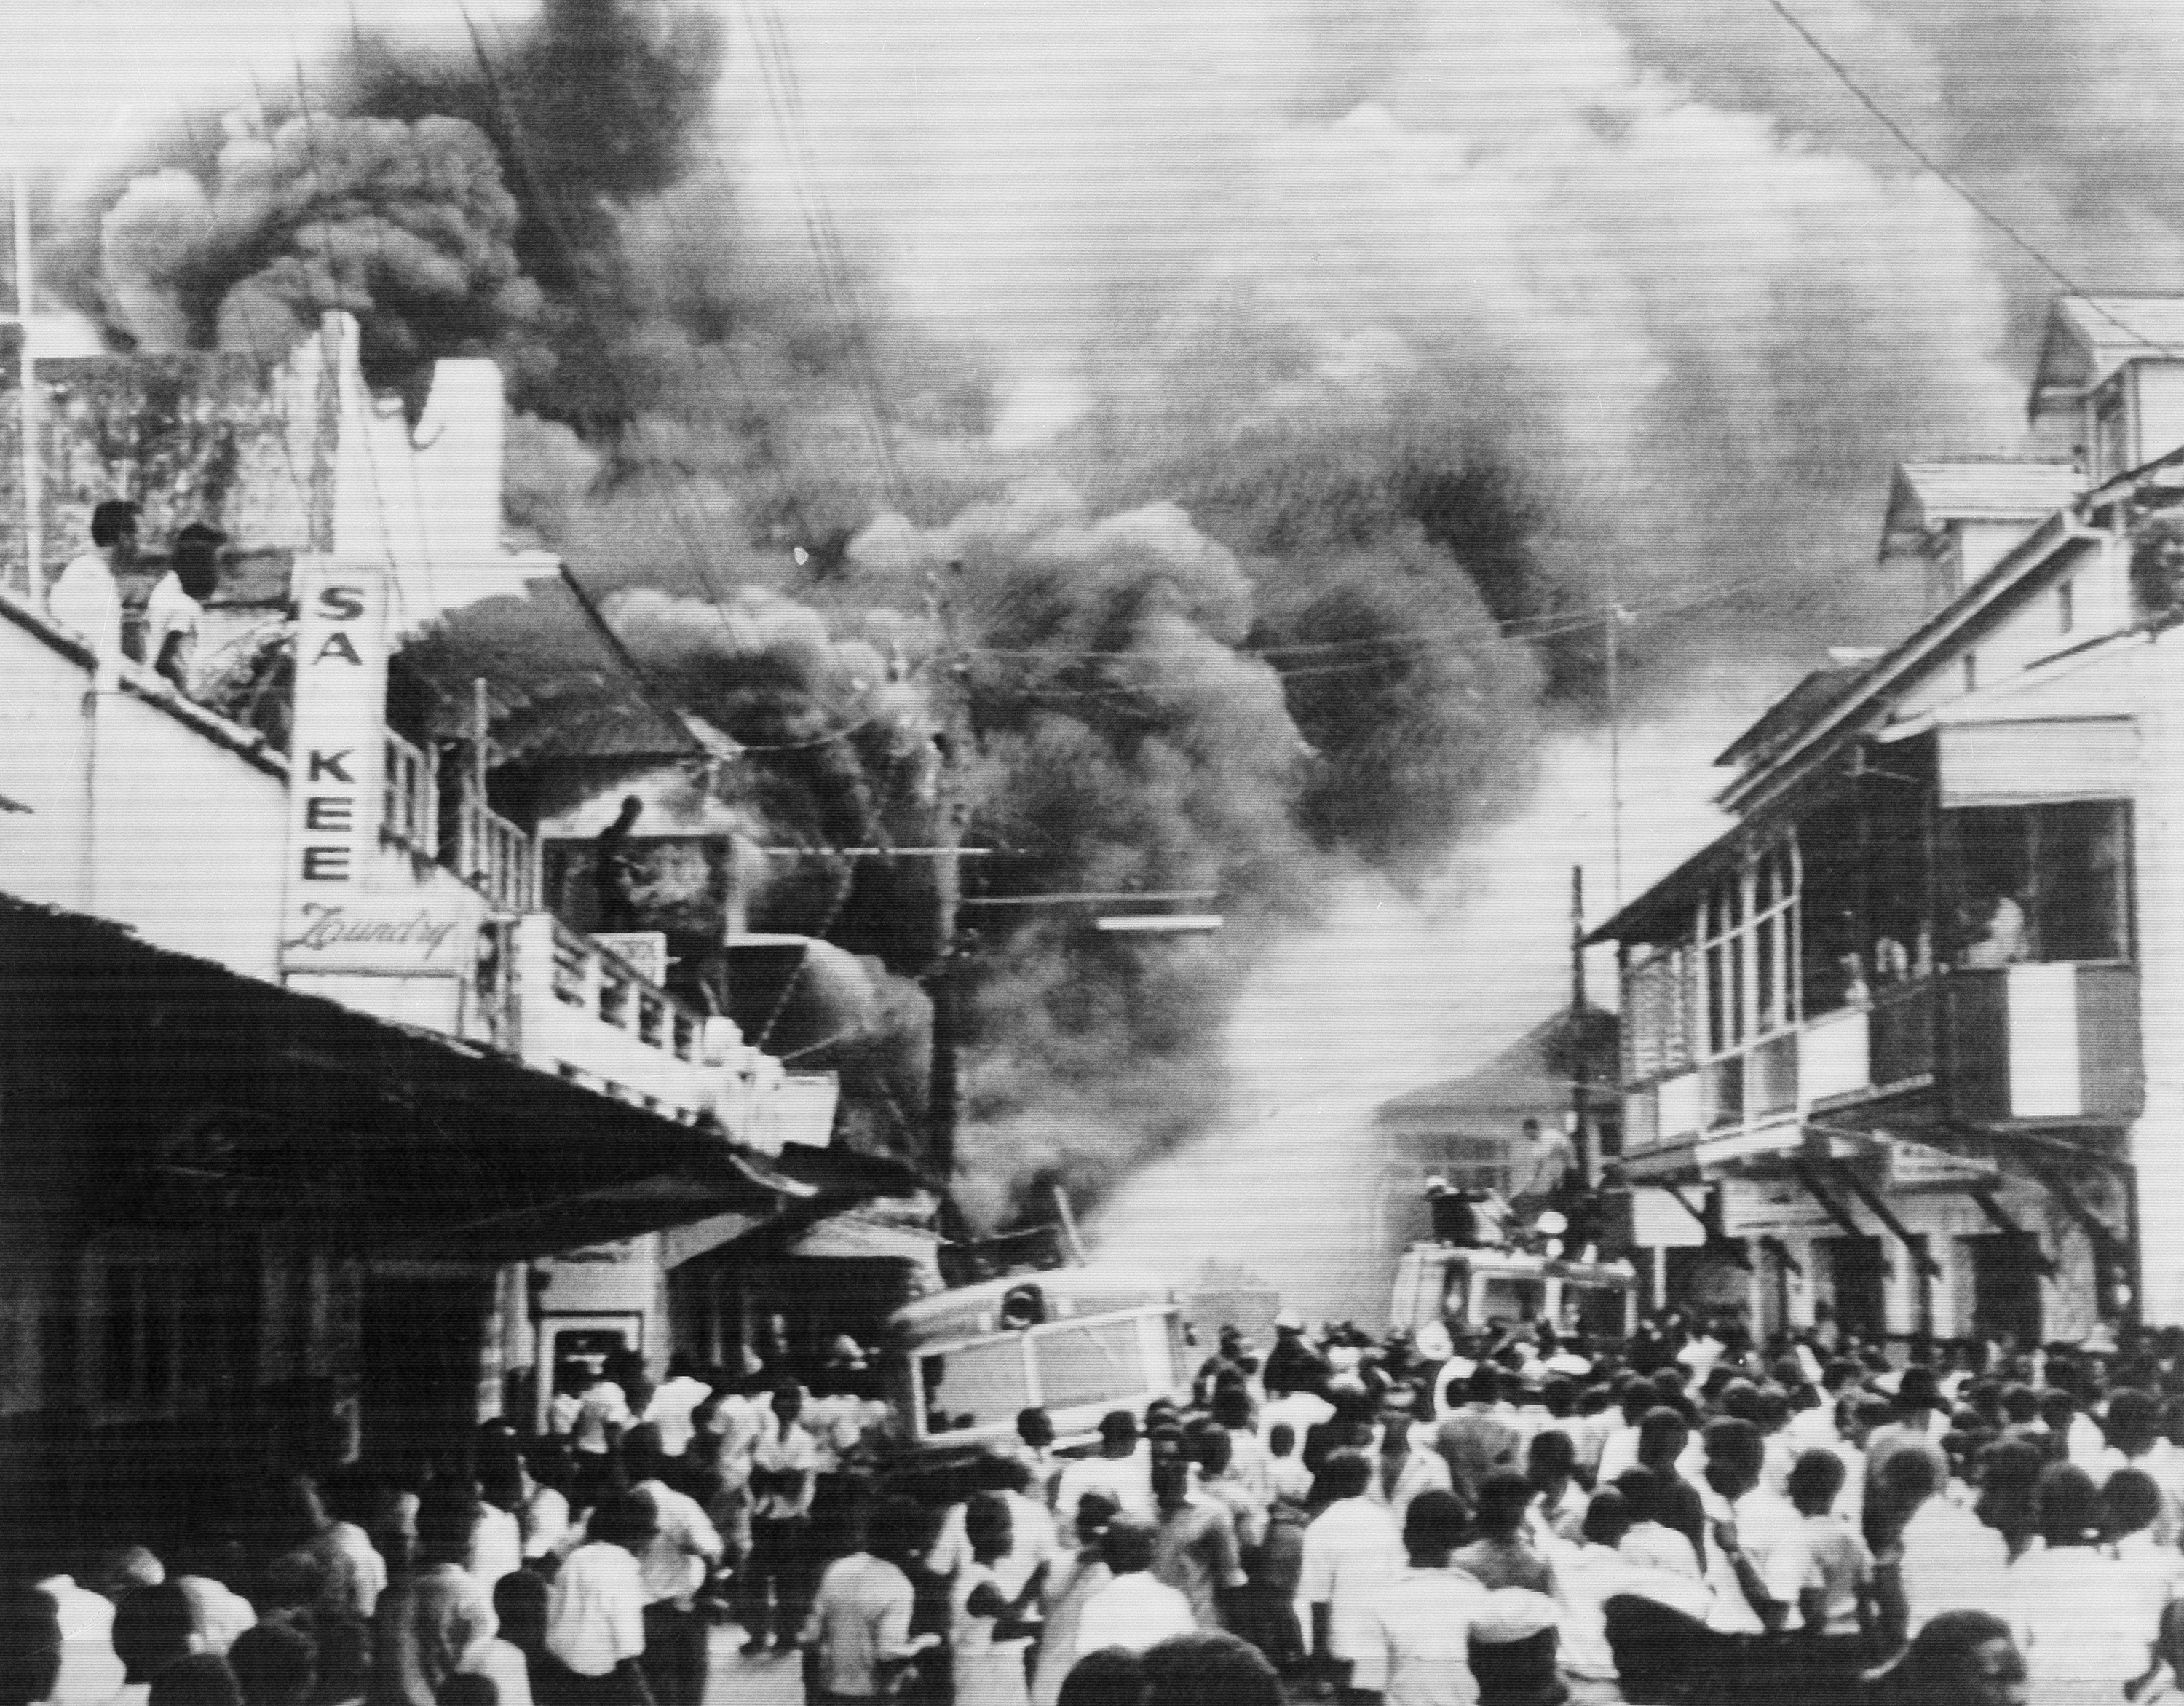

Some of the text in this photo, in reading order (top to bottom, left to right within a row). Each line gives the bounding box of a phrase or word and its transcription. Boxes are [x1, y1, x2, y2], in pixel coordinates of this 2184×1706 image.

[303, 586, 364, 880] SA KEE
[282, 901, 459, 960] Laundry
